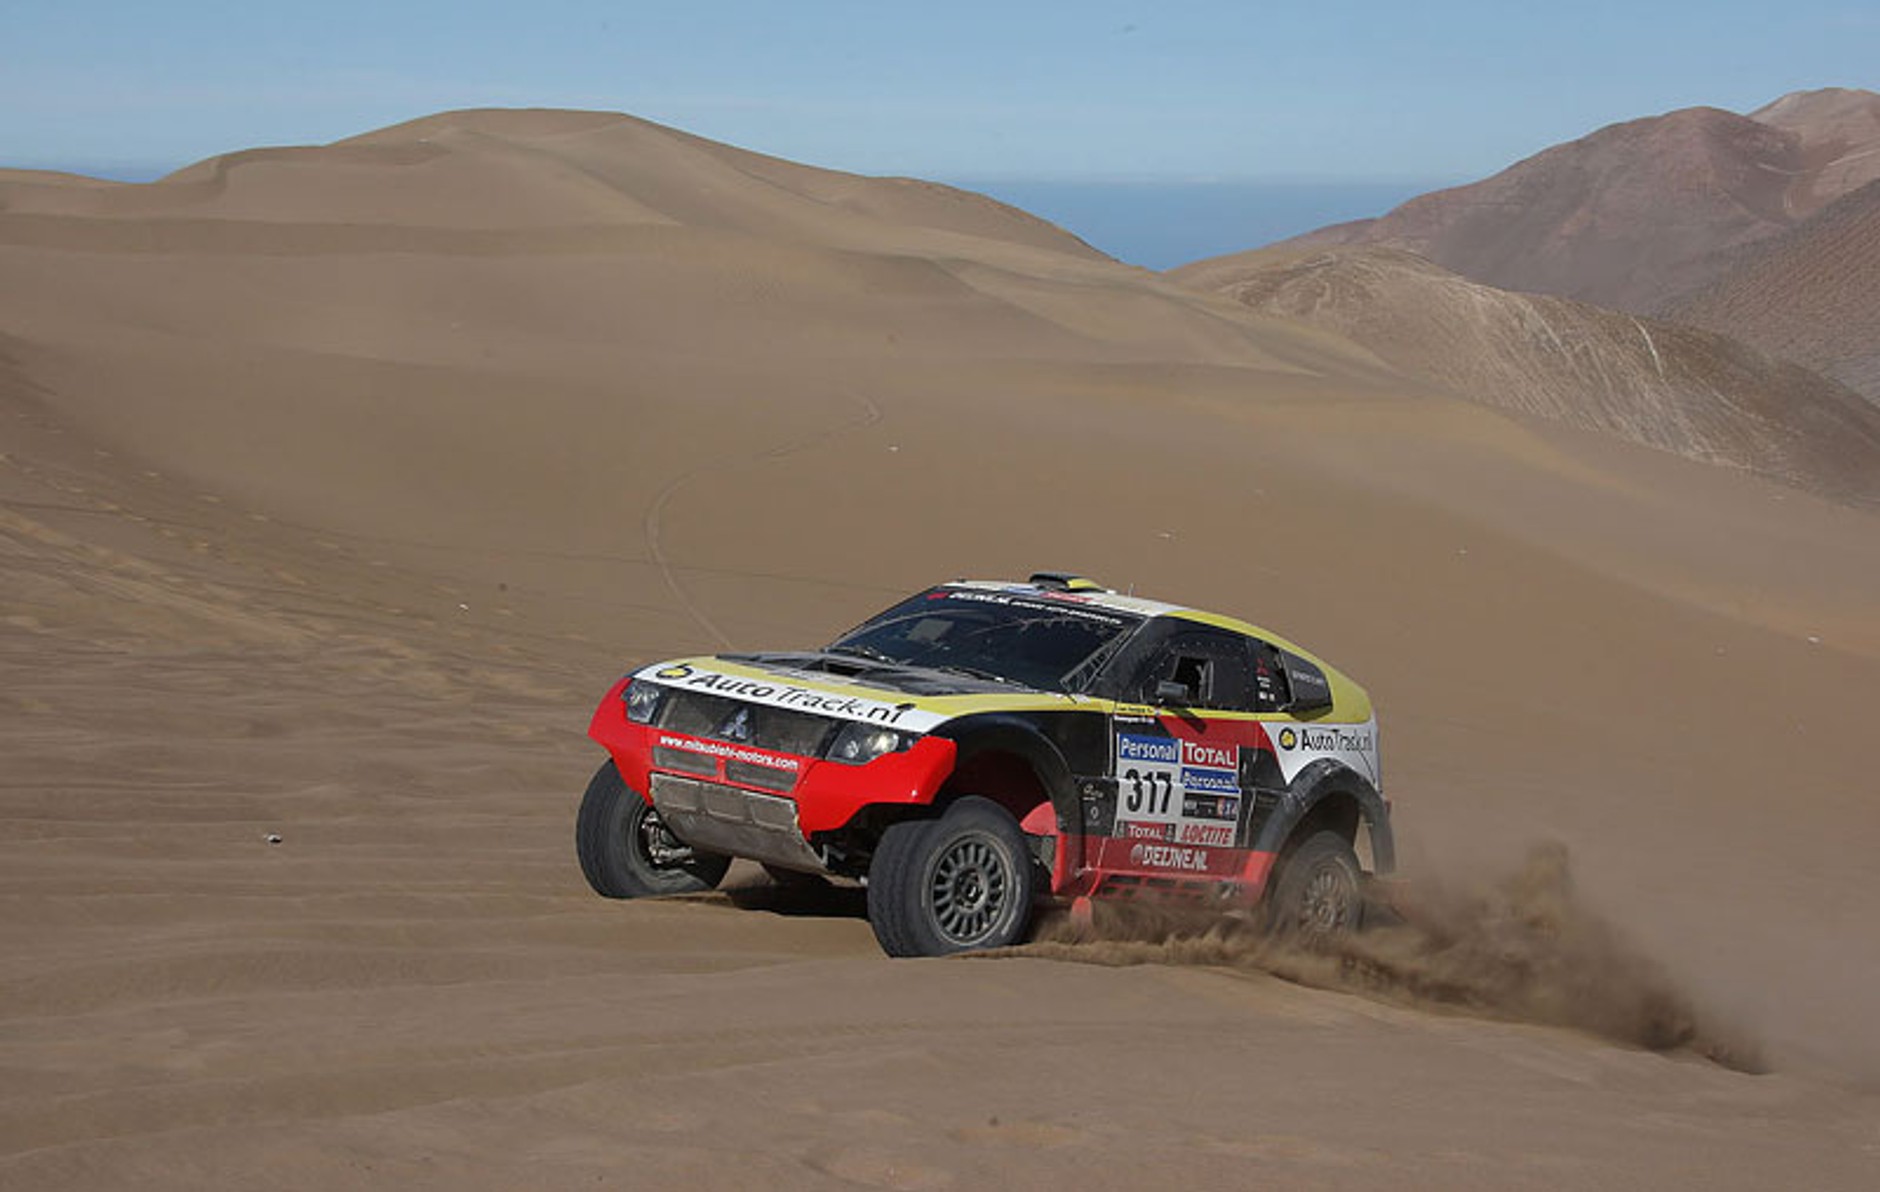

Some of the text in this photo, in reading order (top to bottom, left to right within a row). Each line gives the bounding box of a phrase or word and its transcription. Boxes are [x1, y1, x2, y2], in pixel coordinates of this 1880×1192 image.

[1121, 738, 1177, 761] Personal
[1184, 741, 1235, 766] TOTAL
[1125, 768, 1172, 814] 317
[1128, 825, 1162, 839] TOTAL
[1181, 823, 1233, 846] LOCTITE
